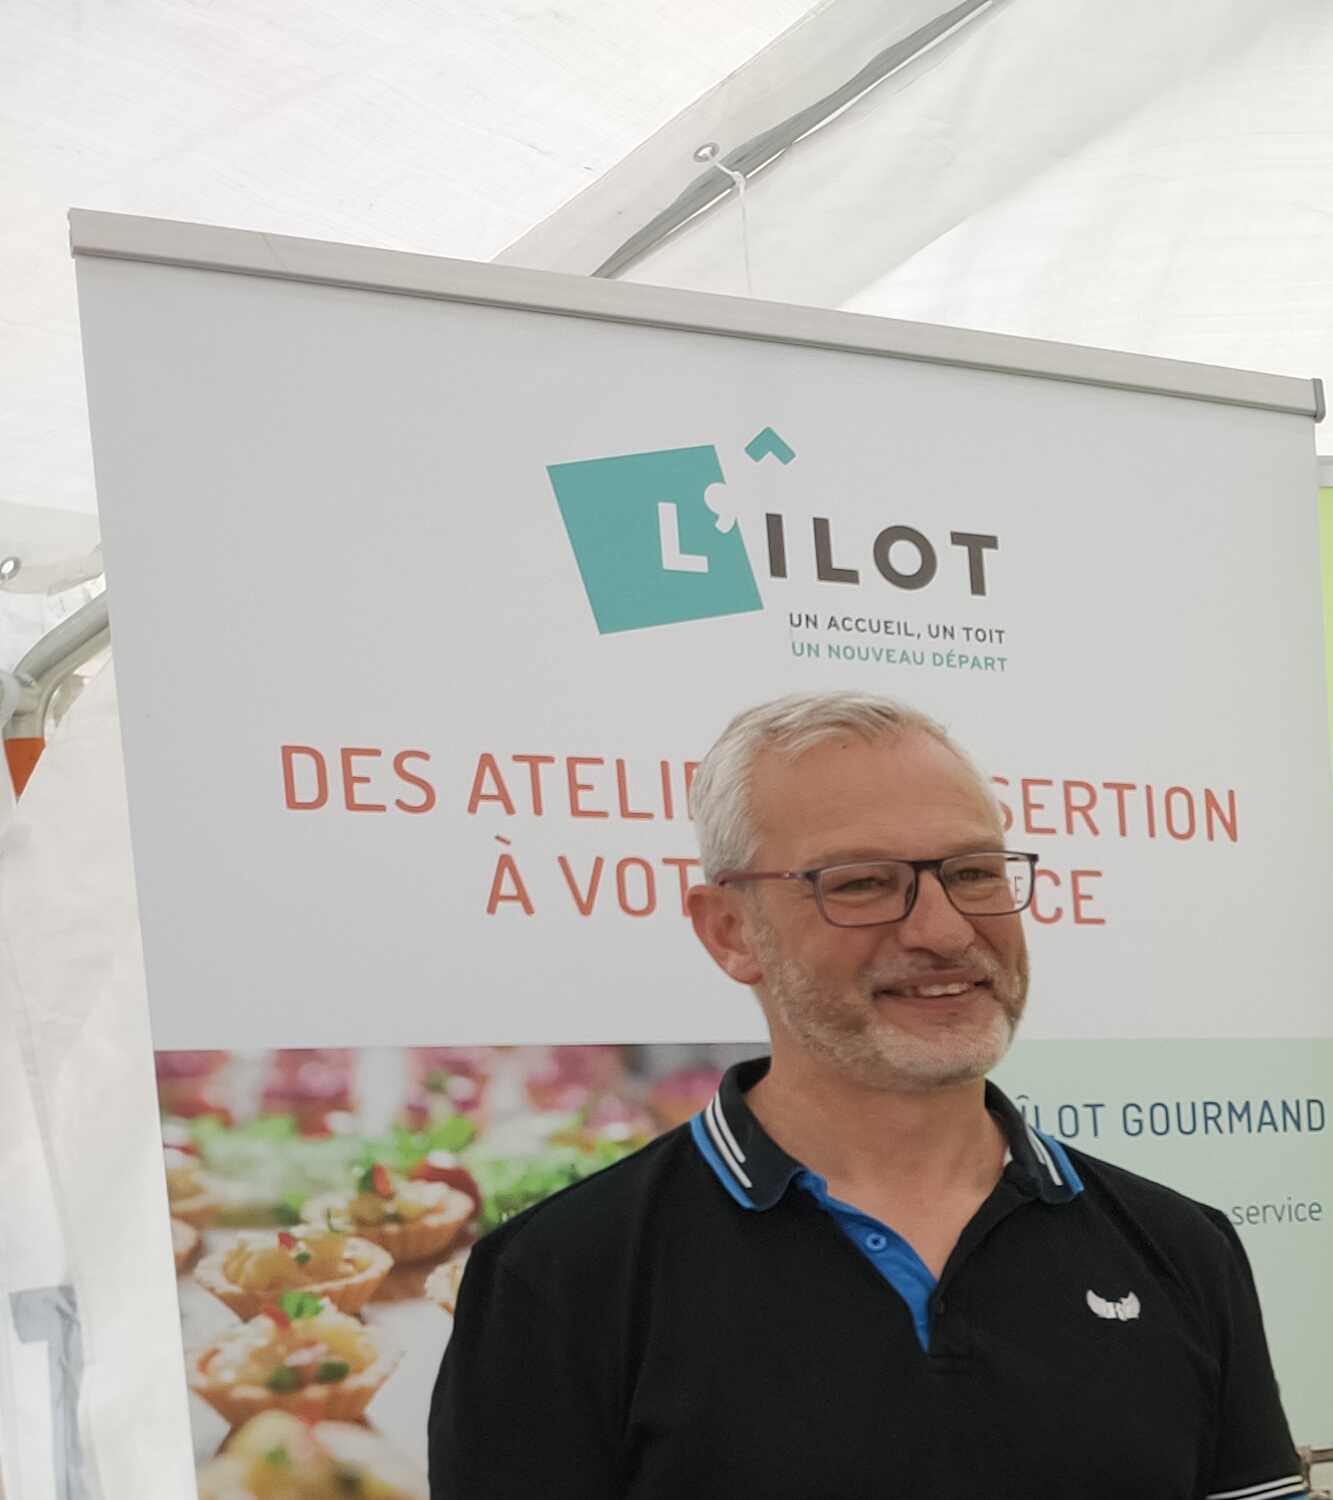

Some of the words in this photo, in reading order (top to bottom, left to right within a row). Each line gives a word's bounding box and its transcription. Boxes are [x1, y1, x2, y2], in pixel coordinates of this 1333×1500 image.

[789, 611, 819, 629] UN
[827, 615, 922, 640] ACCUEIL,
[928, 623, 955, 641] UN
[962, 626, 1006, 645] TOIT
[791, 641, 820, 658] UN
[828, 644, 925, 666] NOUVEAU
[932, 648, 1008, 672] DÉPART
[280, 745, 437, 814] DES
[486, 834, 535, 916] À
[1122, 1099, 1326, 1136] GOURMAND
[1231, 1195, 1323, 1226] service
